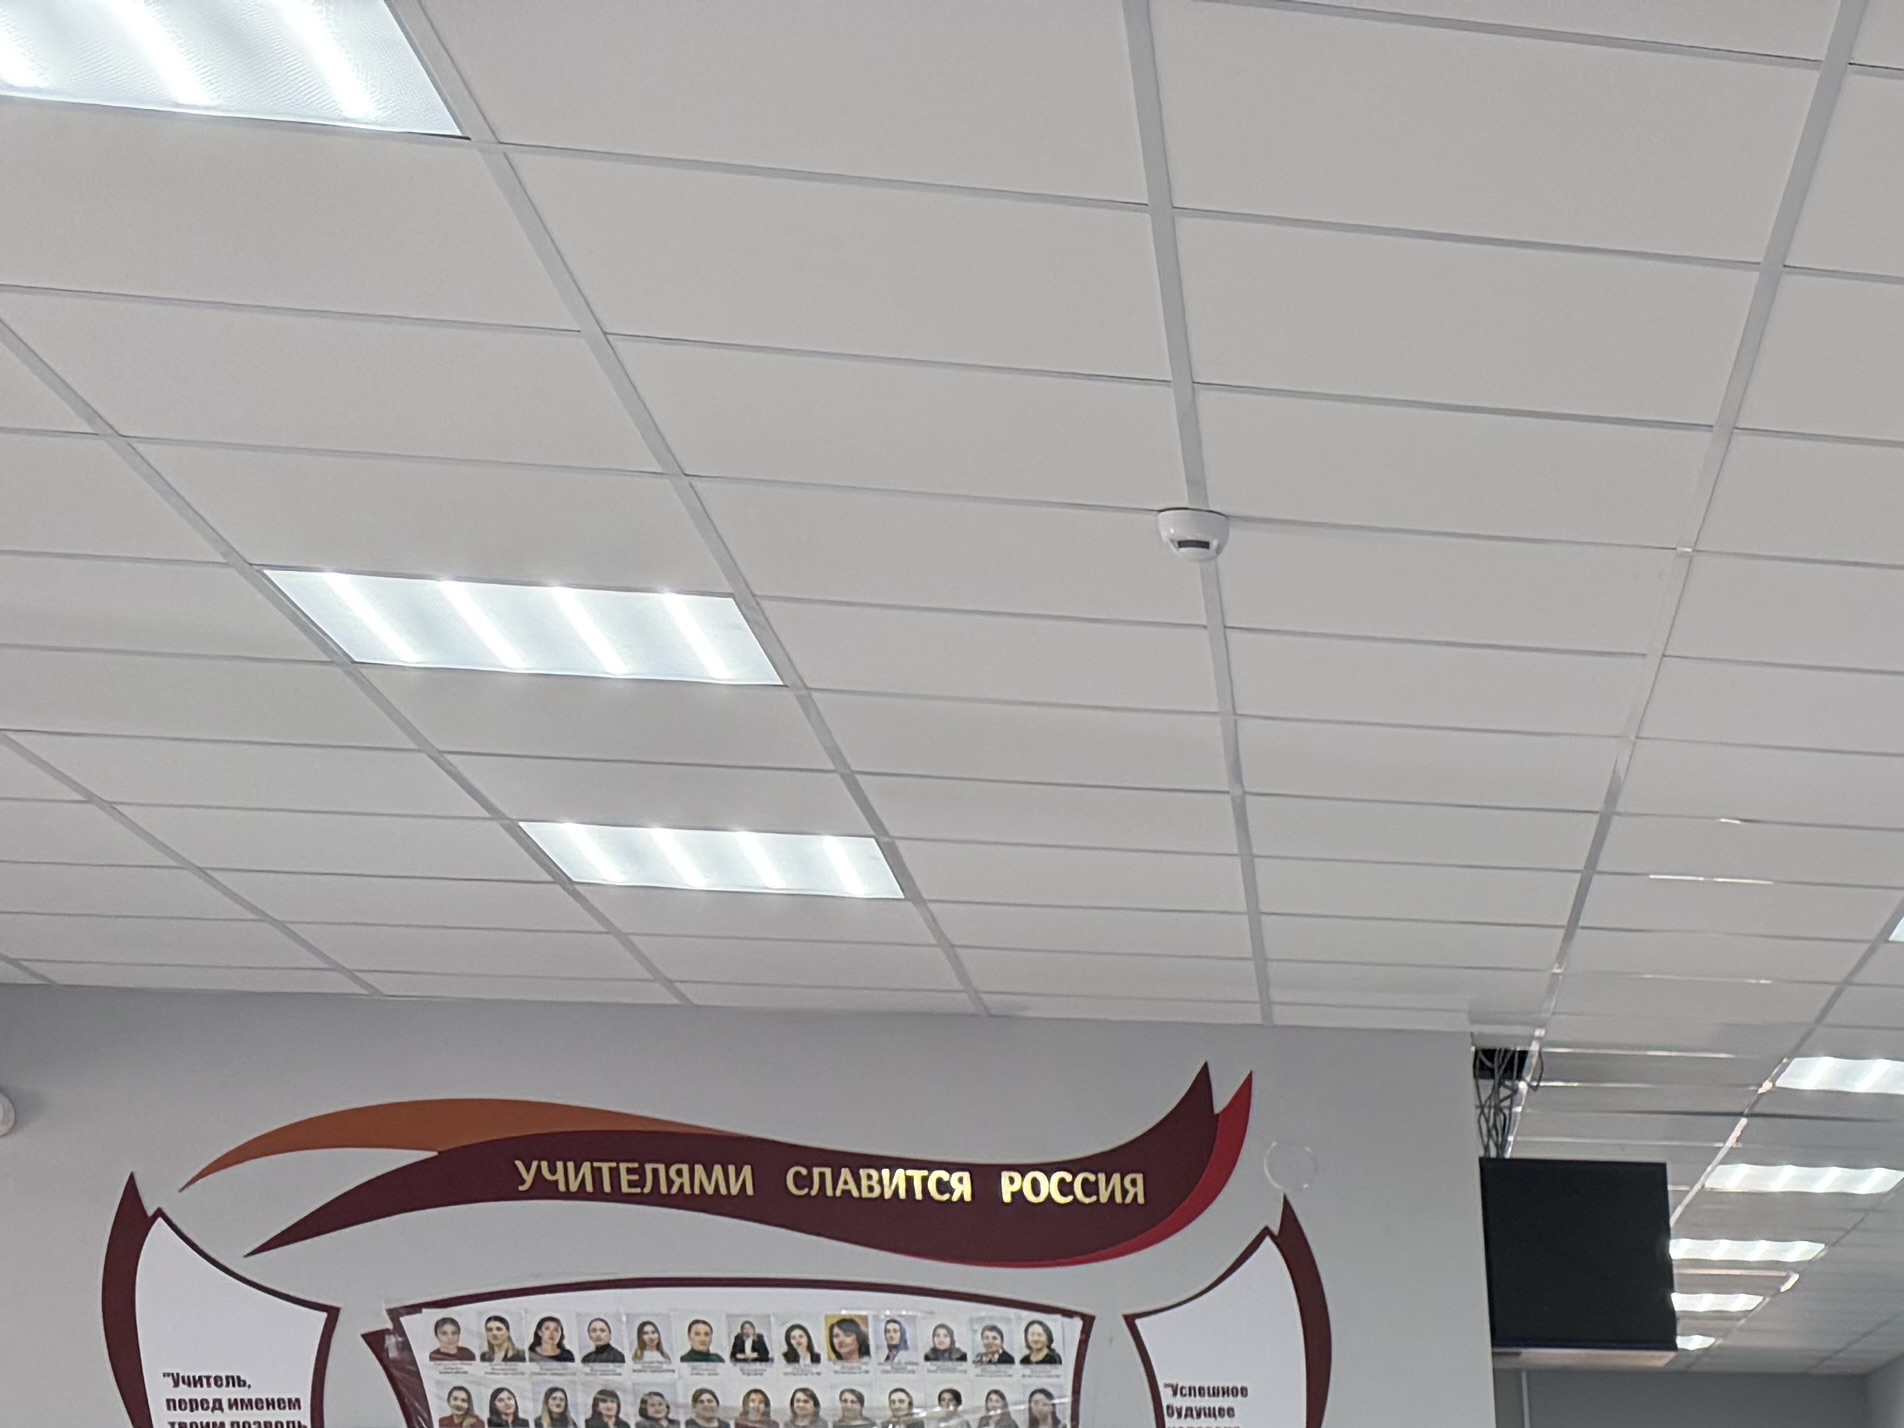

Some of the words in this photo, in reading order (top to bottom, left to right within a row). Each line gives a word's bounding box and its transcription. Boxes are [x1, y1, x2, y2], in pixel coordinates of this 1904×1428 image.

[513, 1159, 755, 1197] УЧИТЕЛЯМИ
[785, 1165, 974, 1203] СЛАВИТСЯ
[1000, 1169, 1147, 1206] РОССИЯ
[165, 1396, 225, 1413] перед
[227, 1396, 302, 1411] именем
[1165, 1403, 1236, 1420] будущее
